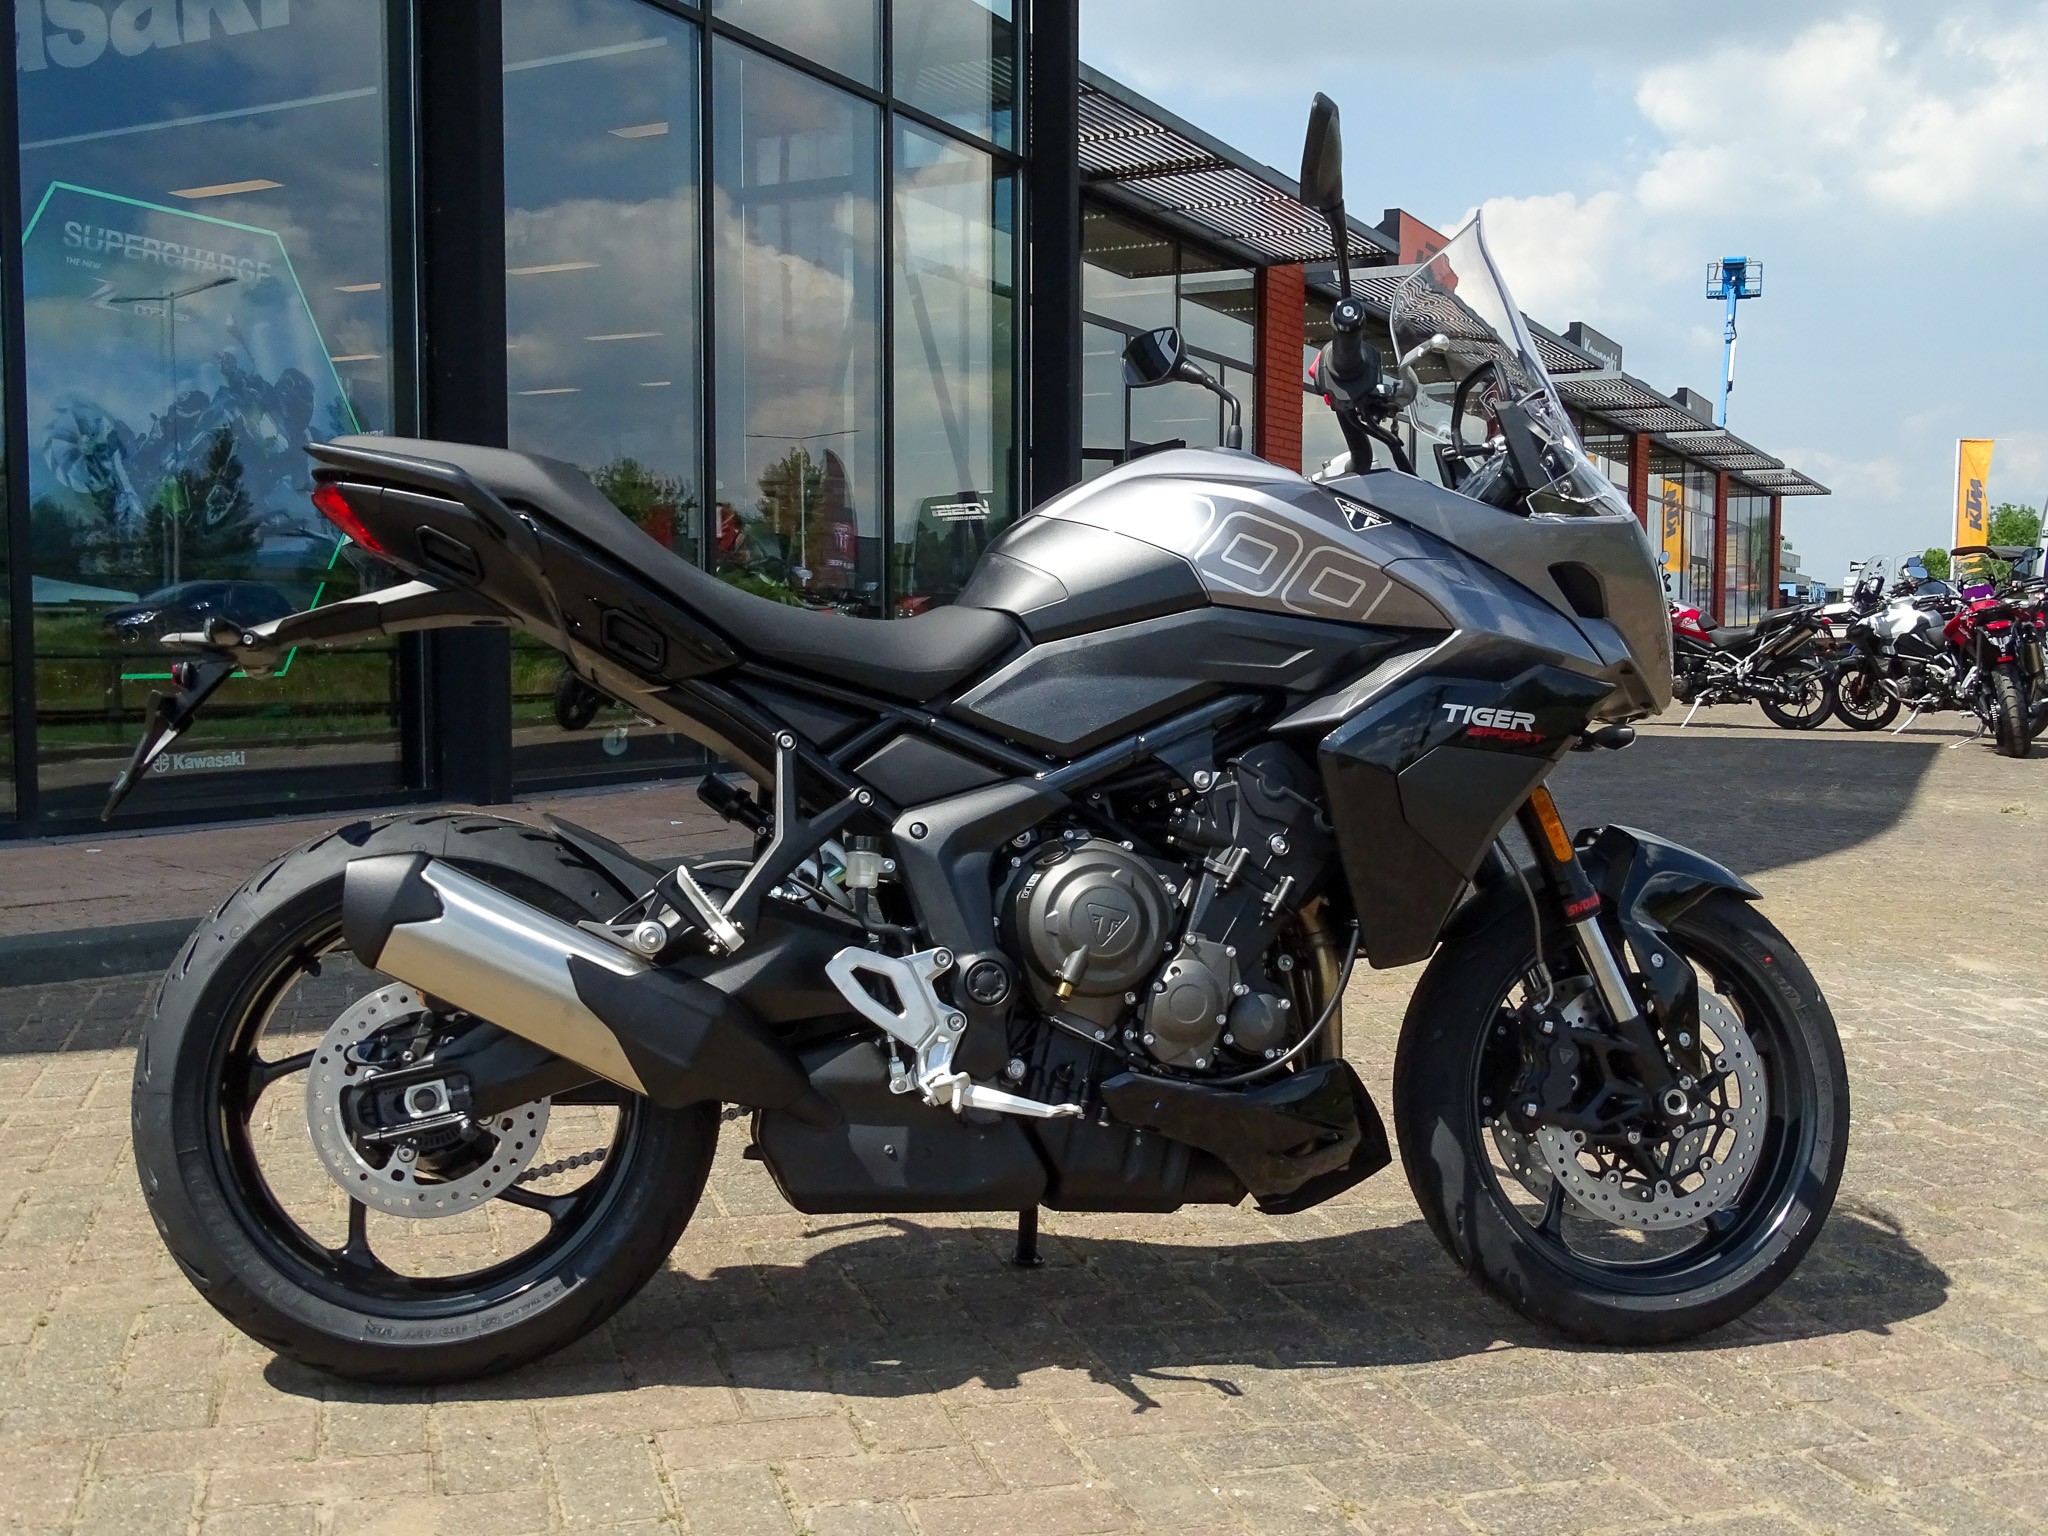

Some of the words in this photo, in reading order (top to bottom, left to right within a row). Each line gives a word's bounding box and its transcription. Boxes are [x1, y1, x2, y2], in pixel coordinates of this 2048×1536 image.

[65, 256, 82, 267] THE
[82, 258, 102, 270] NEW
[1345, 502, 1381, 520] TRIUMPH
[1966, 478, 1983, 532] KTM
[1442, 703, 1536, 733] TIGER
[1466, 726, 1546, 743] SPORT
[173, 751, 246, 770] Kawasaki
